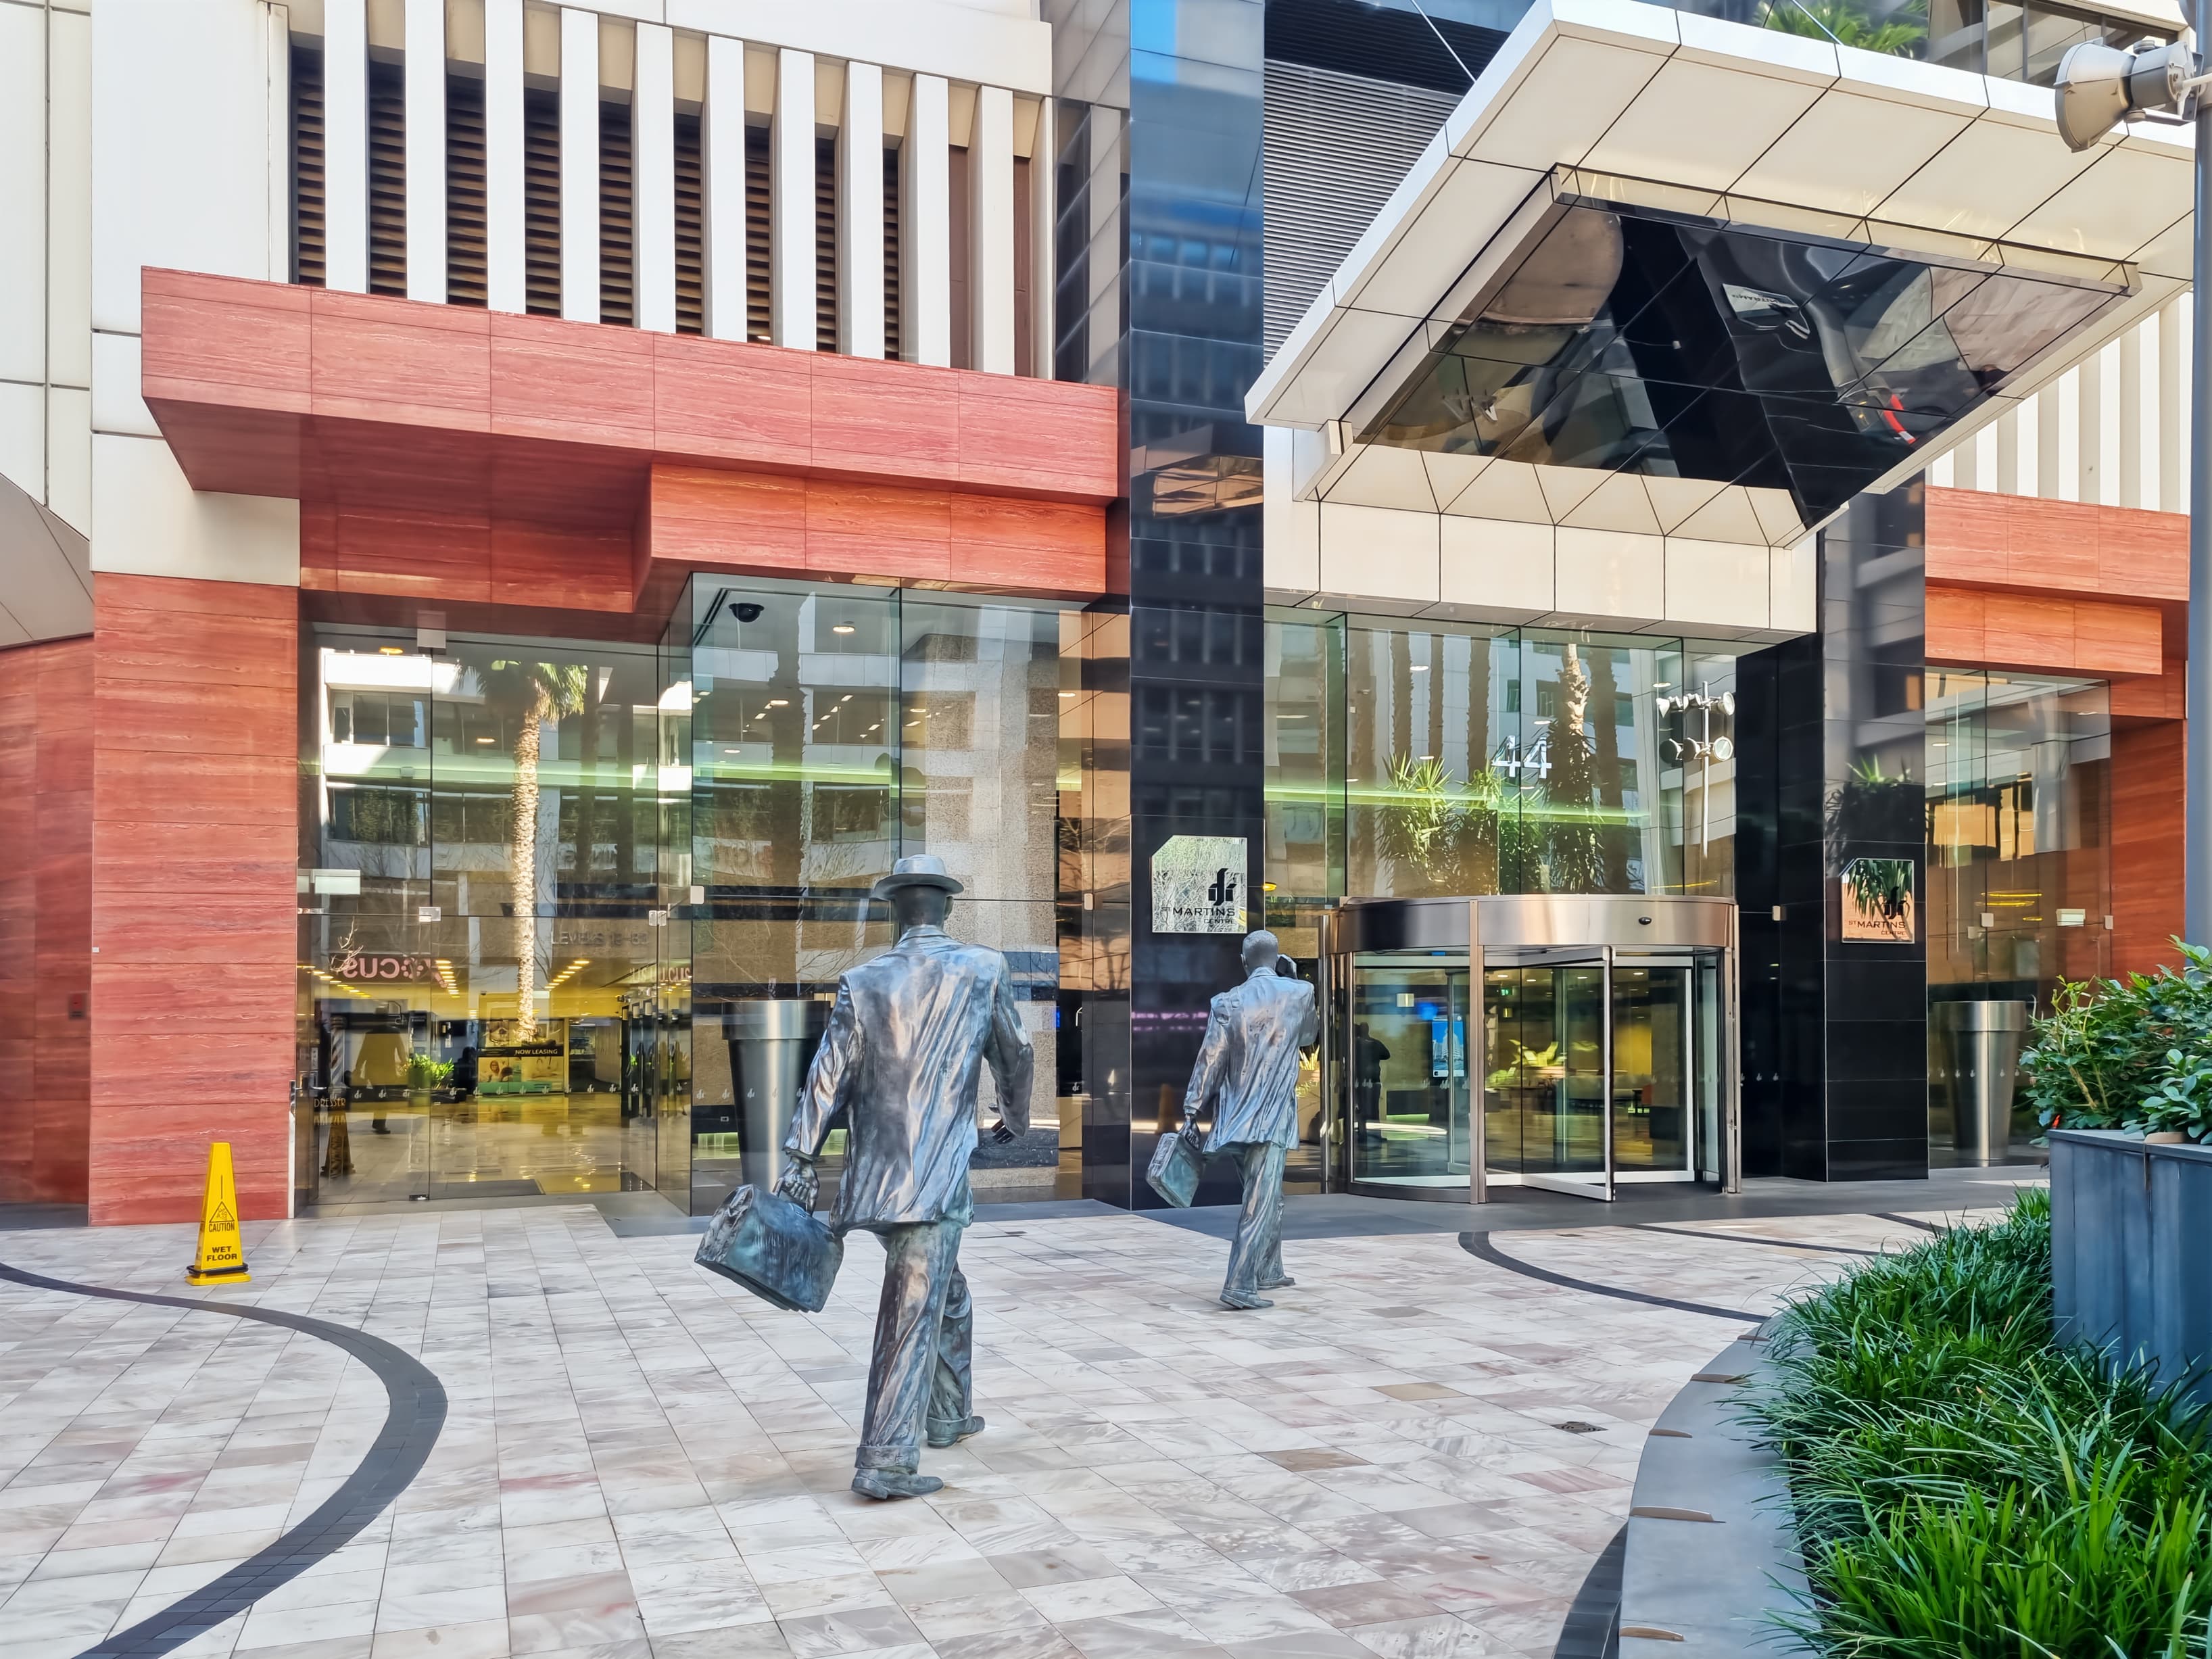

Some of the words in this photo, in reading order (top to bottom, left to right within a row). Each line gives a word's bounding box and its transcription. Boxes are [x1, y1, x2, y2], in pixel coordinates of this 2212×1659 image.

[1491, 735, 1553, 779] 44
[1173, 907, 1235, 917] MARTINS
[1857, 920, 1906, 929] MARTINS
[314, 1097, 346, 1108] DRESSER
[208, 1222, 235, 1232] CAUTION
[206, 1253, 238, 1262] FLOOR
